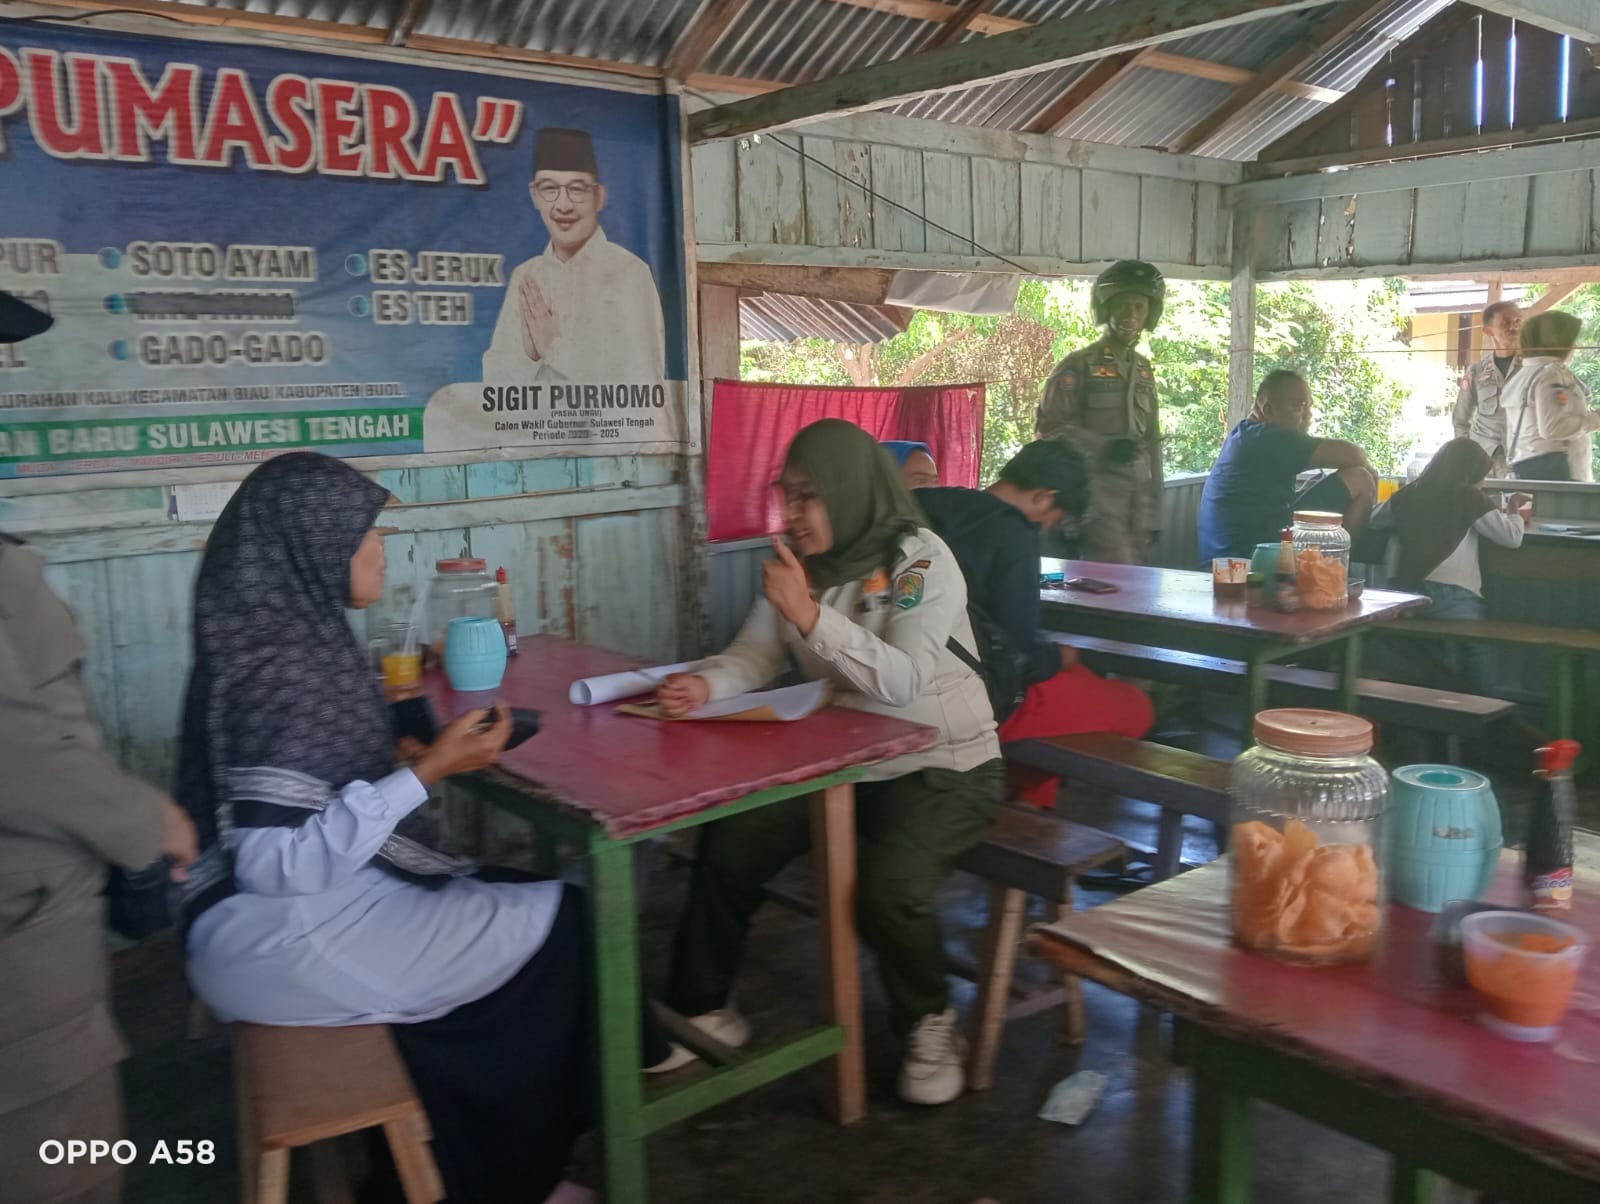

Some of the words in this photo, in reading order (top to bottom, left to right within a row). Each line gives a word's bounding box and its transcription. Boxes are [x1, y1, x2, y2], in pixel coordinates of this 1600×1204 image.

[130, 244, 217, 278] SOTO
[226, 247, 314, 280] AYAM
[372, 252, 407, 282] ES
[413, 254, 502, 284] JERUK
[376, 293, 410, 322] ES
[415, 294, 472, 322] TEH
[140, 333, 328, 366] GADO-GADO
[274, 384, 360, 399] KABUPATEN
[366, 383, 404, 397] BUOL
[482, 385, 542, 412] SIGIT
[550, 384, 665, 410] PURNOMO
[48, 425, 139, 455] BARU
[146, 418, 301, 450] SULAWESI
[305, 414, 410, 441] TENGAH
[495, 421, 519, 431] Calon
[521, 419, 545, 430] Wakil
[590, 417, 625, 429] Sulawesi
[626, 416, 655, 429] Tengah
[533, 430, 566, 441] Periode
[600, 428, 620, 438] 2025
